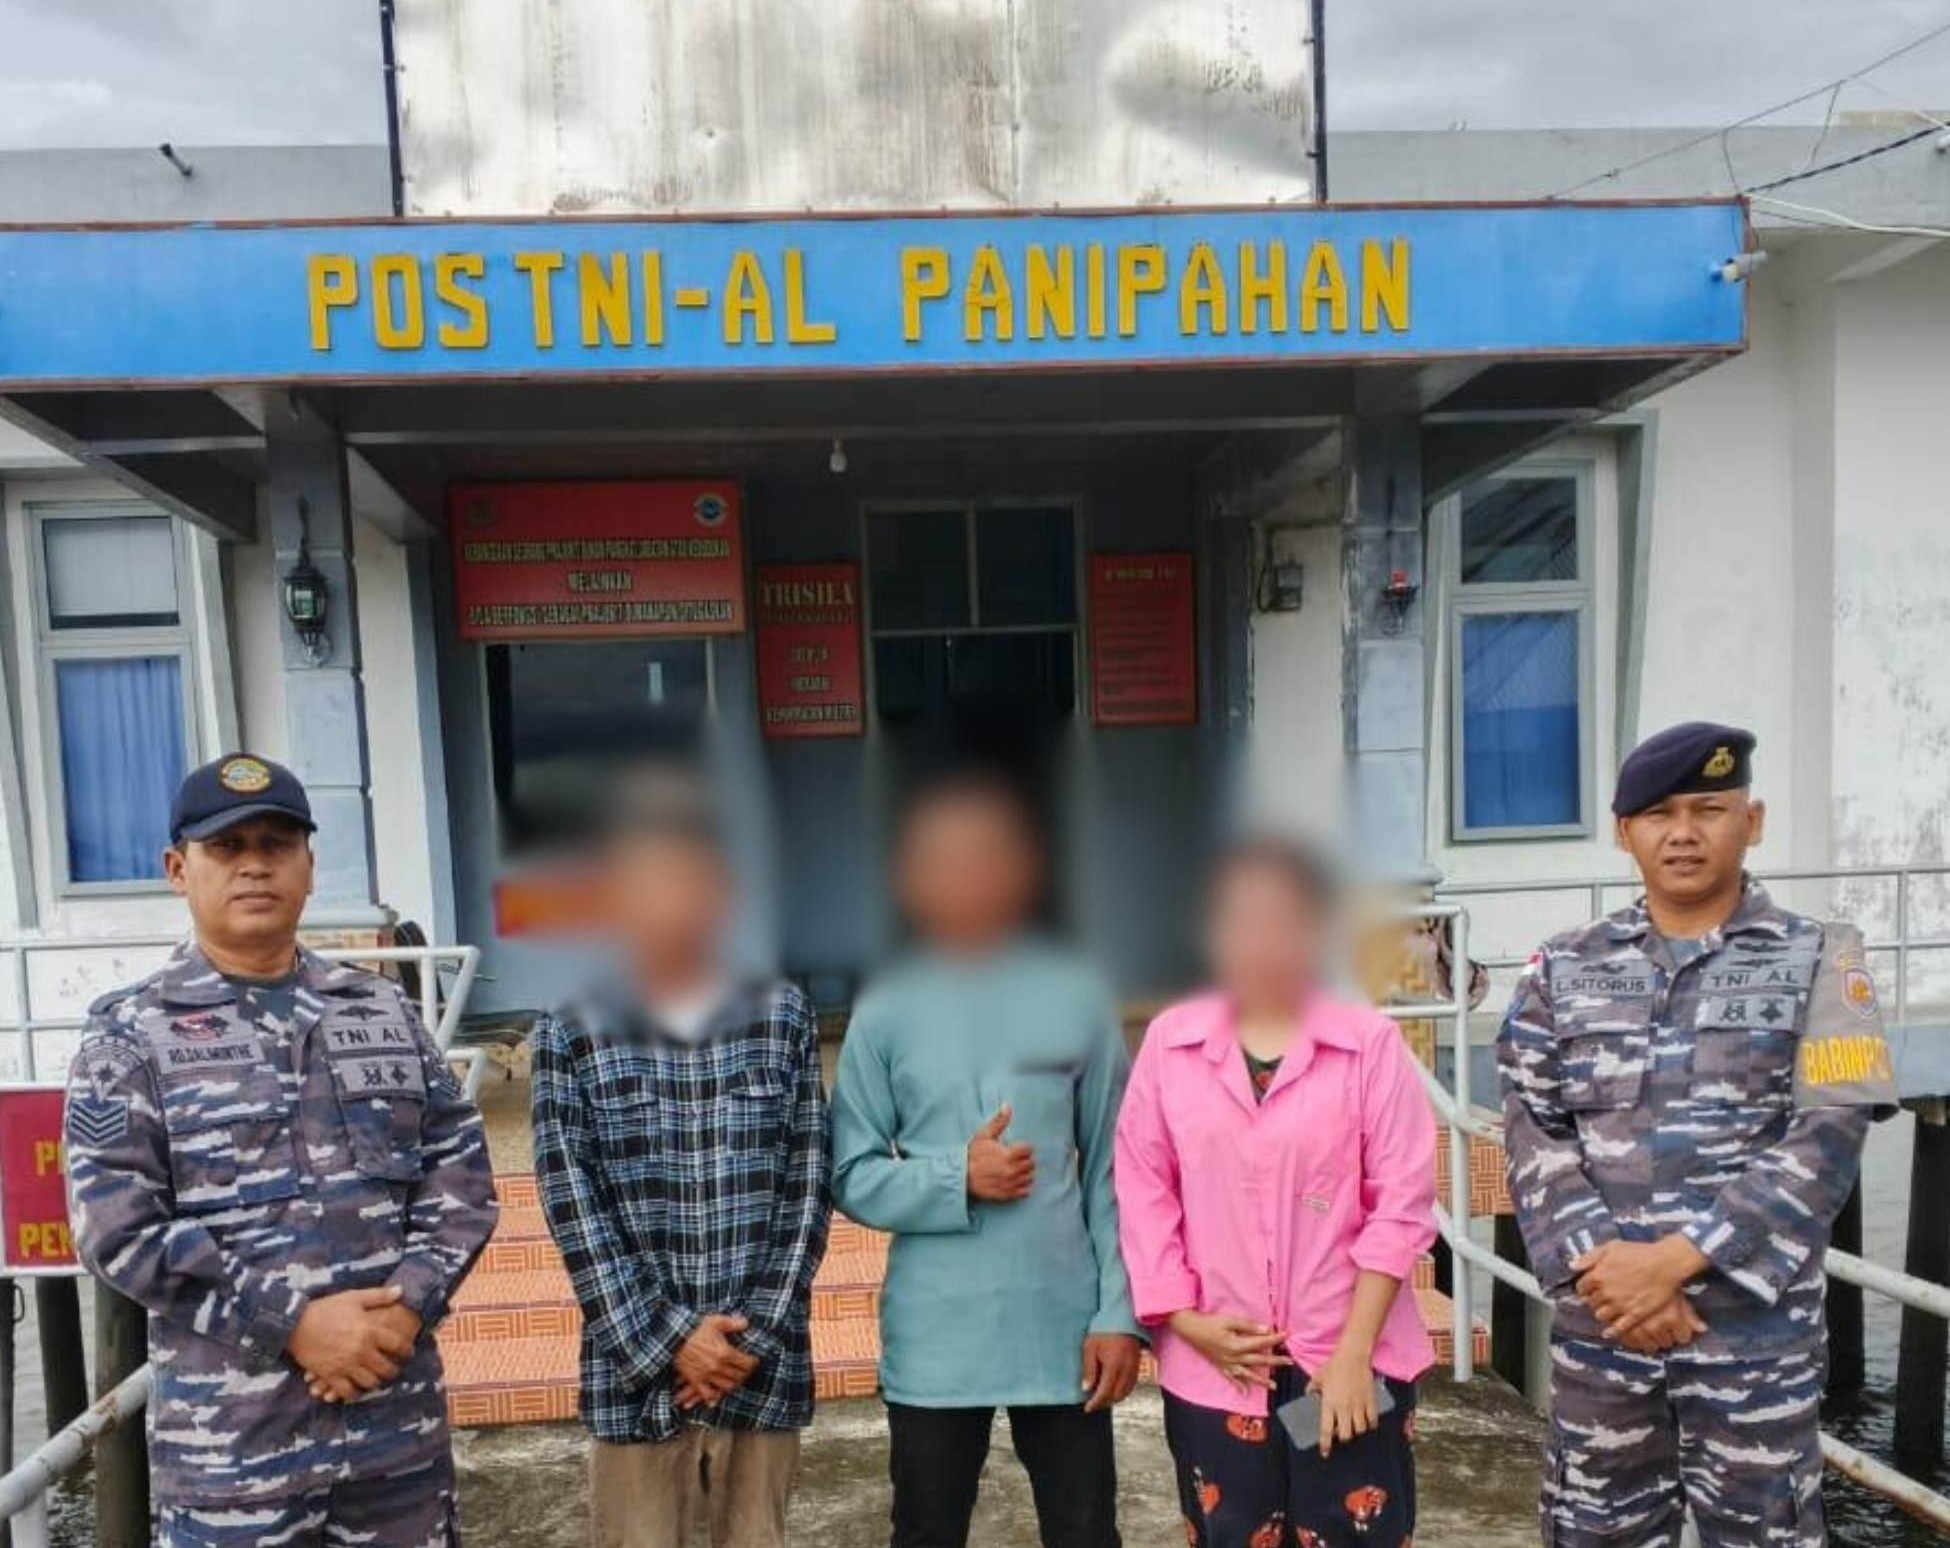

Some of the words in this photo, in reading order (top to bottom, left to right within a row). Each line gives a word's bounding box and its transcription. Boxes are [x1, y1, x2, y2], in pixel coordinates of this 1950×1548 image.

[307, 251, 489, 350] POS
[514, 248, 837, 348] TNI-AL
[901, 237, 1411, 342] PANIPAHAN
[1711, 973, 1749, 988] TNI
[1768, 969, 1799, 984] AL
[332, 1028, 371, 1046] TNI
[382, 1026, 409, 1042] AL
